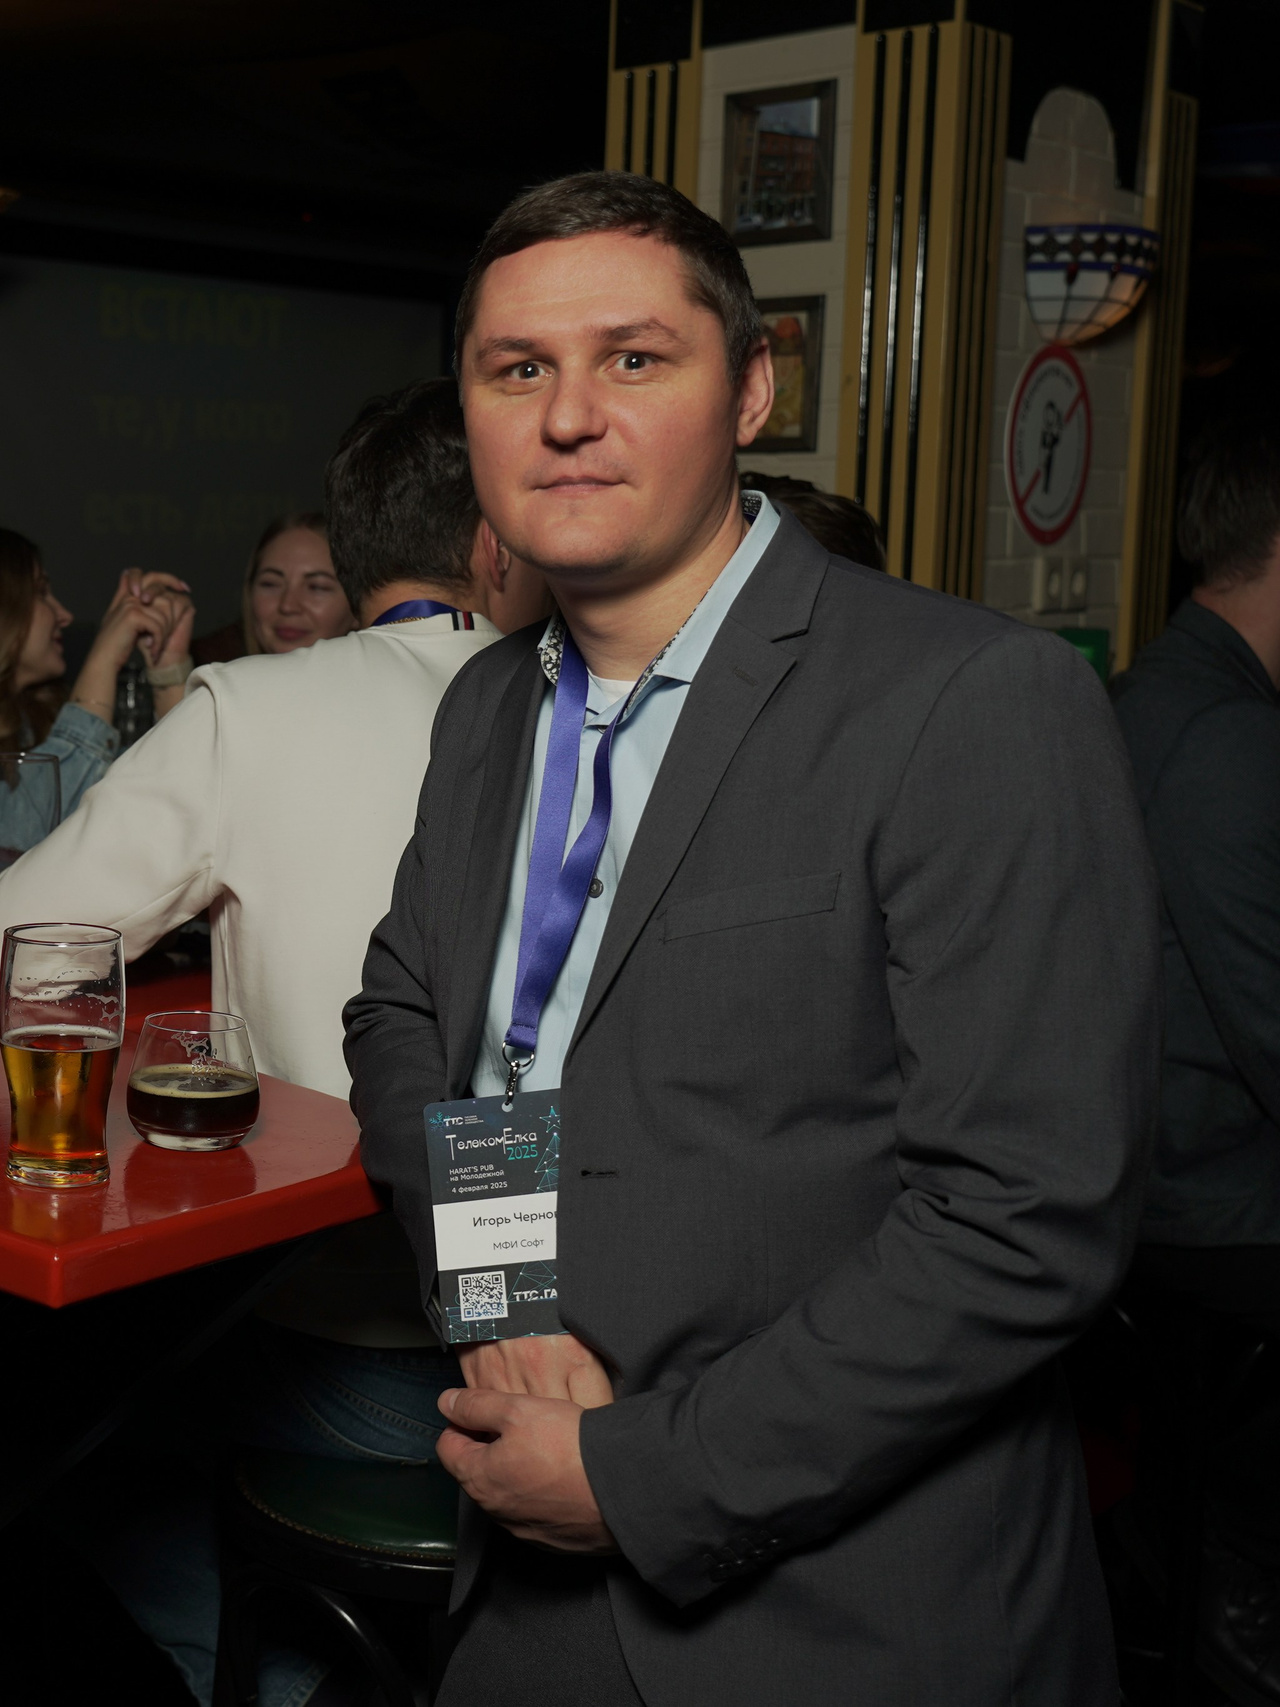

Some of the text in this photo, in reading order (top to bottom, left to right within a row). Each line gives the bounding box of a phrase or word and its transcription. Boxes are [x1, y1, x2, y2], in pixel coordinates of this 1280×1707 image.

[100, 284, 289, 348] ВСТАЮТ
[82, 491, 184, 535] есть
[507, 1144, 538, 1161] 2025
[449, 1164, 494, 1175] HARAT'S PUB
[460, 1169, 505, 1181] Молодежной
[458, 1184, 489, 1193] февраля
[490, 1181, 508, 1190] 2025
[472, 1215, 511, 1227] Игорь
[493, 1238, 544, 1250] МФИ Софт
